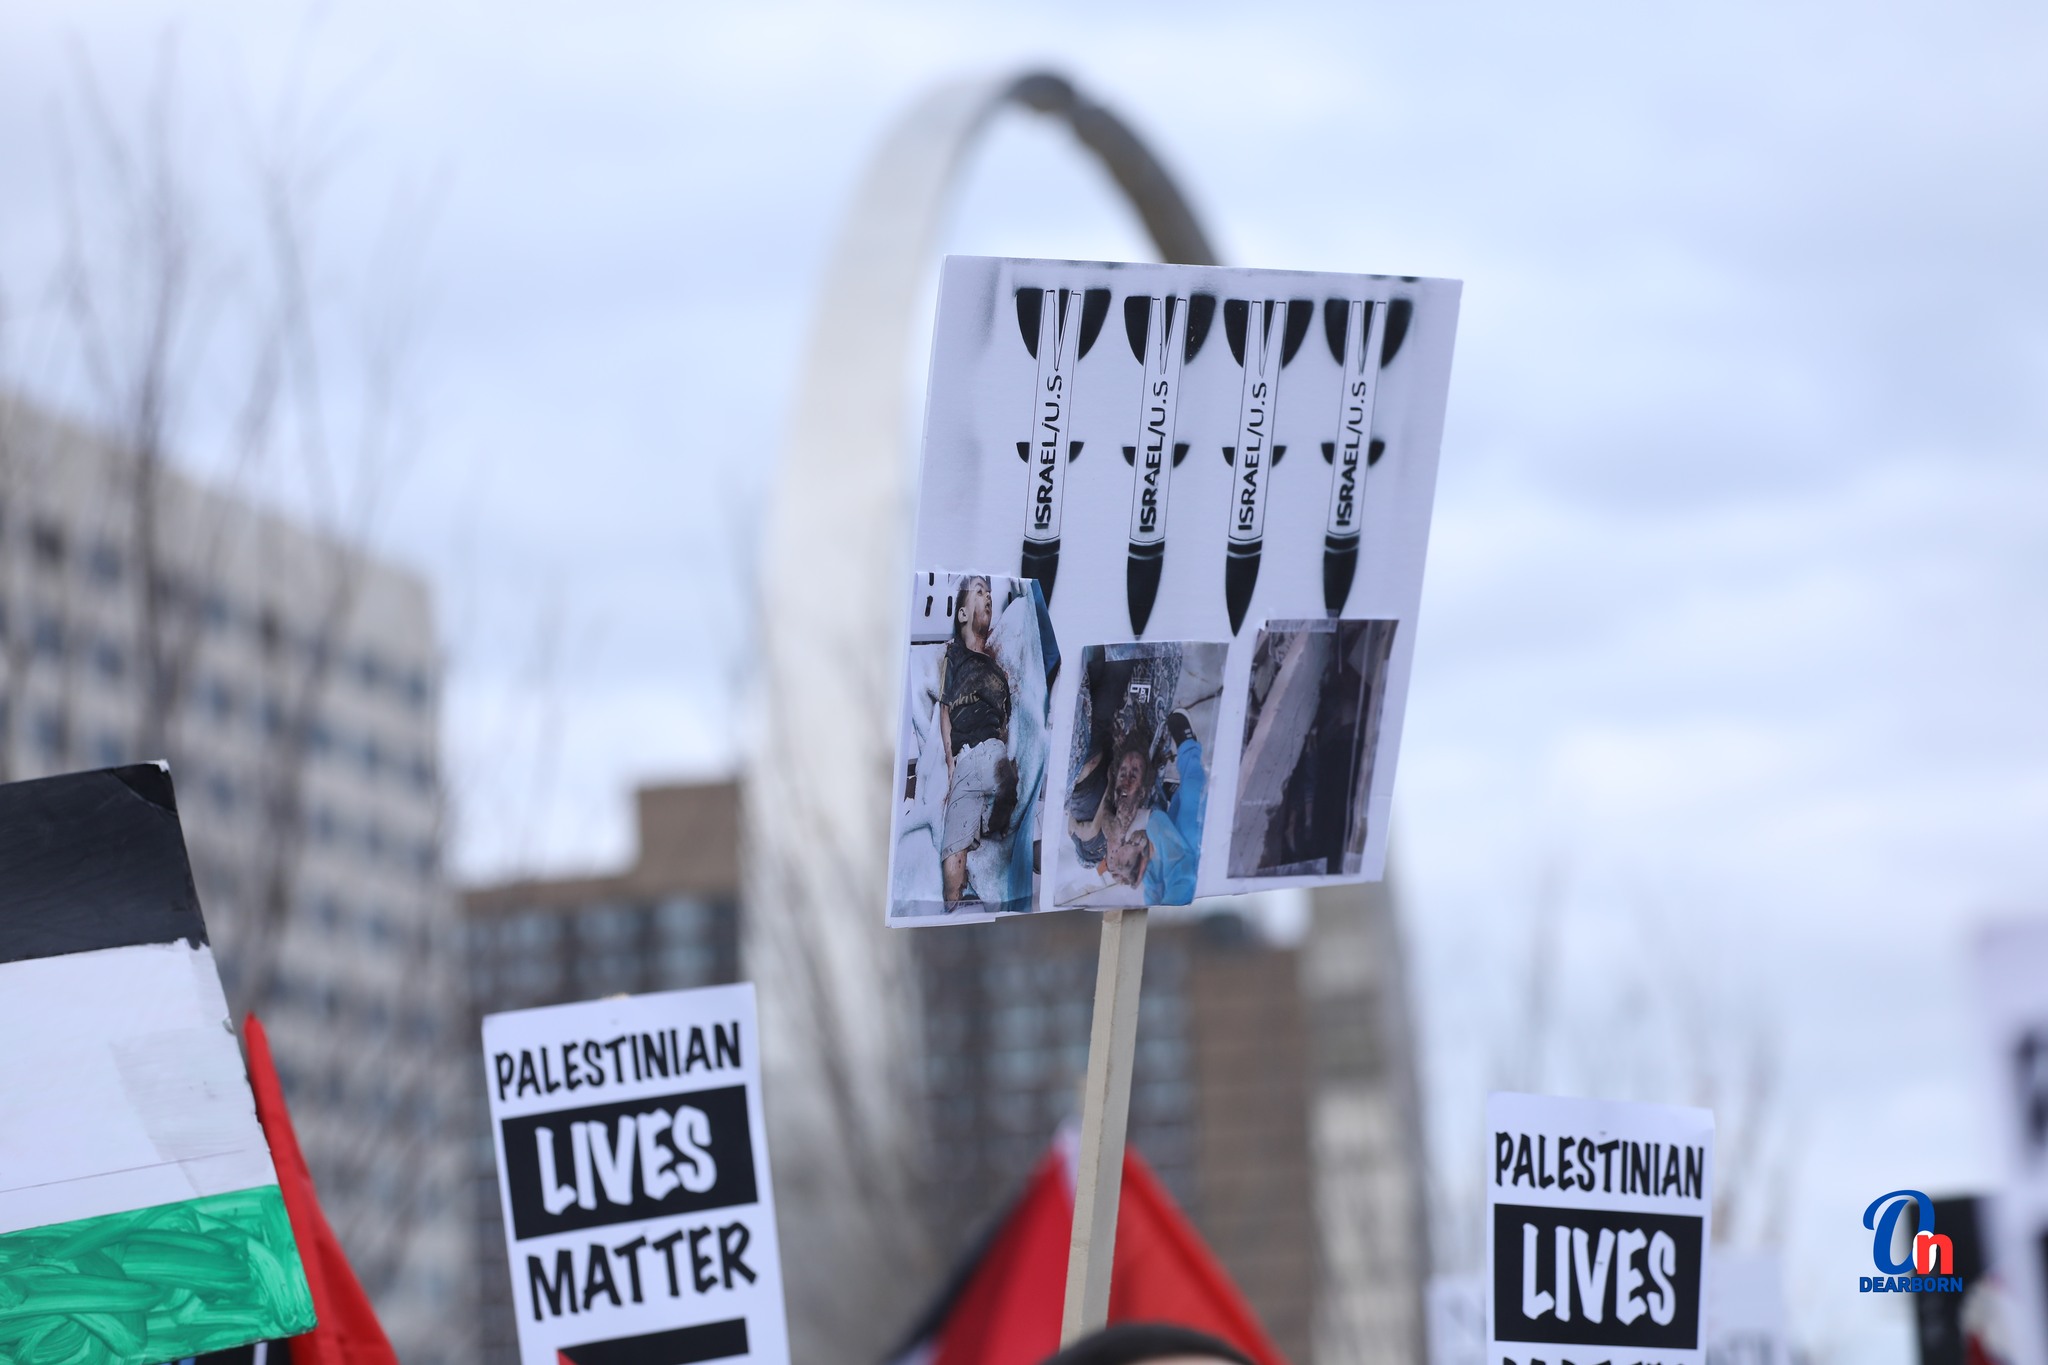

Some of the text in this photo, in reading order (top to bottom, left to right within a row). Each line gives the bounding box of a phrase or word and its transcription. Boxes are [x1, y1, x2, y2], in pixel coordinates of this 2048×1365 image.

[1034, 375, 1062, 530] ISRAEL/U.S
[1139, 381, 1168, 533] ISRAEL/U.S
[1238, 382, 1267, 530] ISRAEL/U.S
[1336, 381, 1366, 526] ISRAEL/U.S
[494, 1020, 742, 1101] PALESTINIAN
[535, 1104, 717, 1215] LIVES
[1495, 1131, 1704, 1200] PALESTINIAN
[527, 1221, 757, 1321] MATTER
[1522, 1222, 1676, 1326] LIVES
